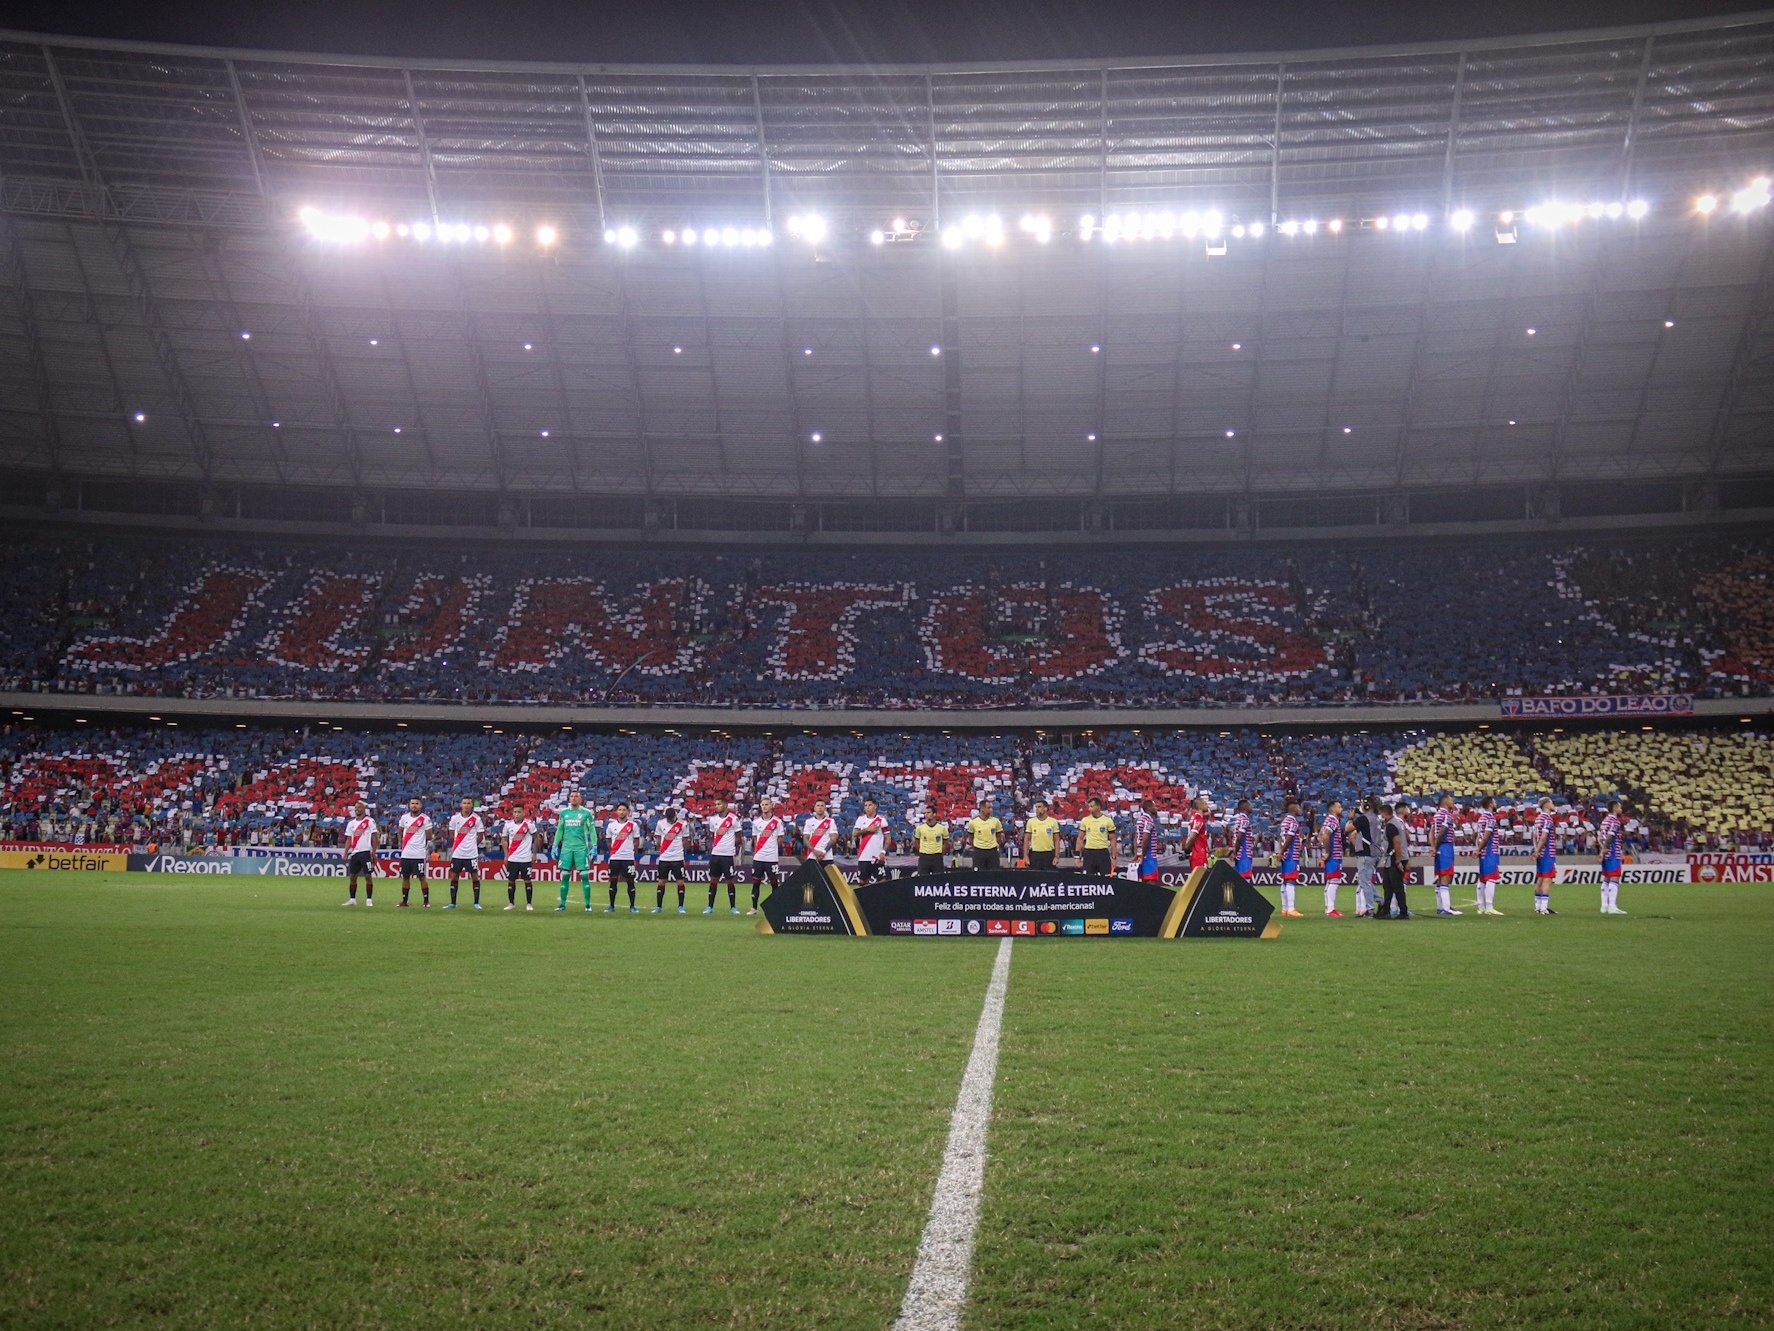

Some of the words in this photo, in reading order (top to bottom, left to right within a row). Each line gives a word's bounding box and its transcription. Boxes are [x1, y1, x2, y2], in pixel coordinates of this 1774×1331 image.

[58, 565, 1337, 683] JUNTOS
[1522, 697, 1577, 713] BAFO
[1581, 697, 1611, 713] DO
[49, 854, 109, 871] betfair
[161, 855, 231, 875] Rexona
[275, 858, 347, 877] Rexona
[914, 883, 952, 897] MAMÁ
[954, 885, 968, 897] ES
[970, 886, 1017, 898] ETERNA
[1019, 886, 1027, 900] /
[1029, 883, 1056, 898] MÃE
[1057, 882, 1065, 897] É
[1067, 884, 1115, 897] ETERNA
[934, 902, 951, 911] Feliz
[952, 902, 963, 911] dia
[965, 904, 981, 912] para
[983, 903, 1004, 911] todas
[1015, 903, 1036, 911] mães
[1037, 901, 1095, 911] sul-americanas!
[891, 922, 912, 930] QATAR
[1112, 921, 1132, 931] Ford
[1205, 916, 1253, 924] LIBERTADORES
